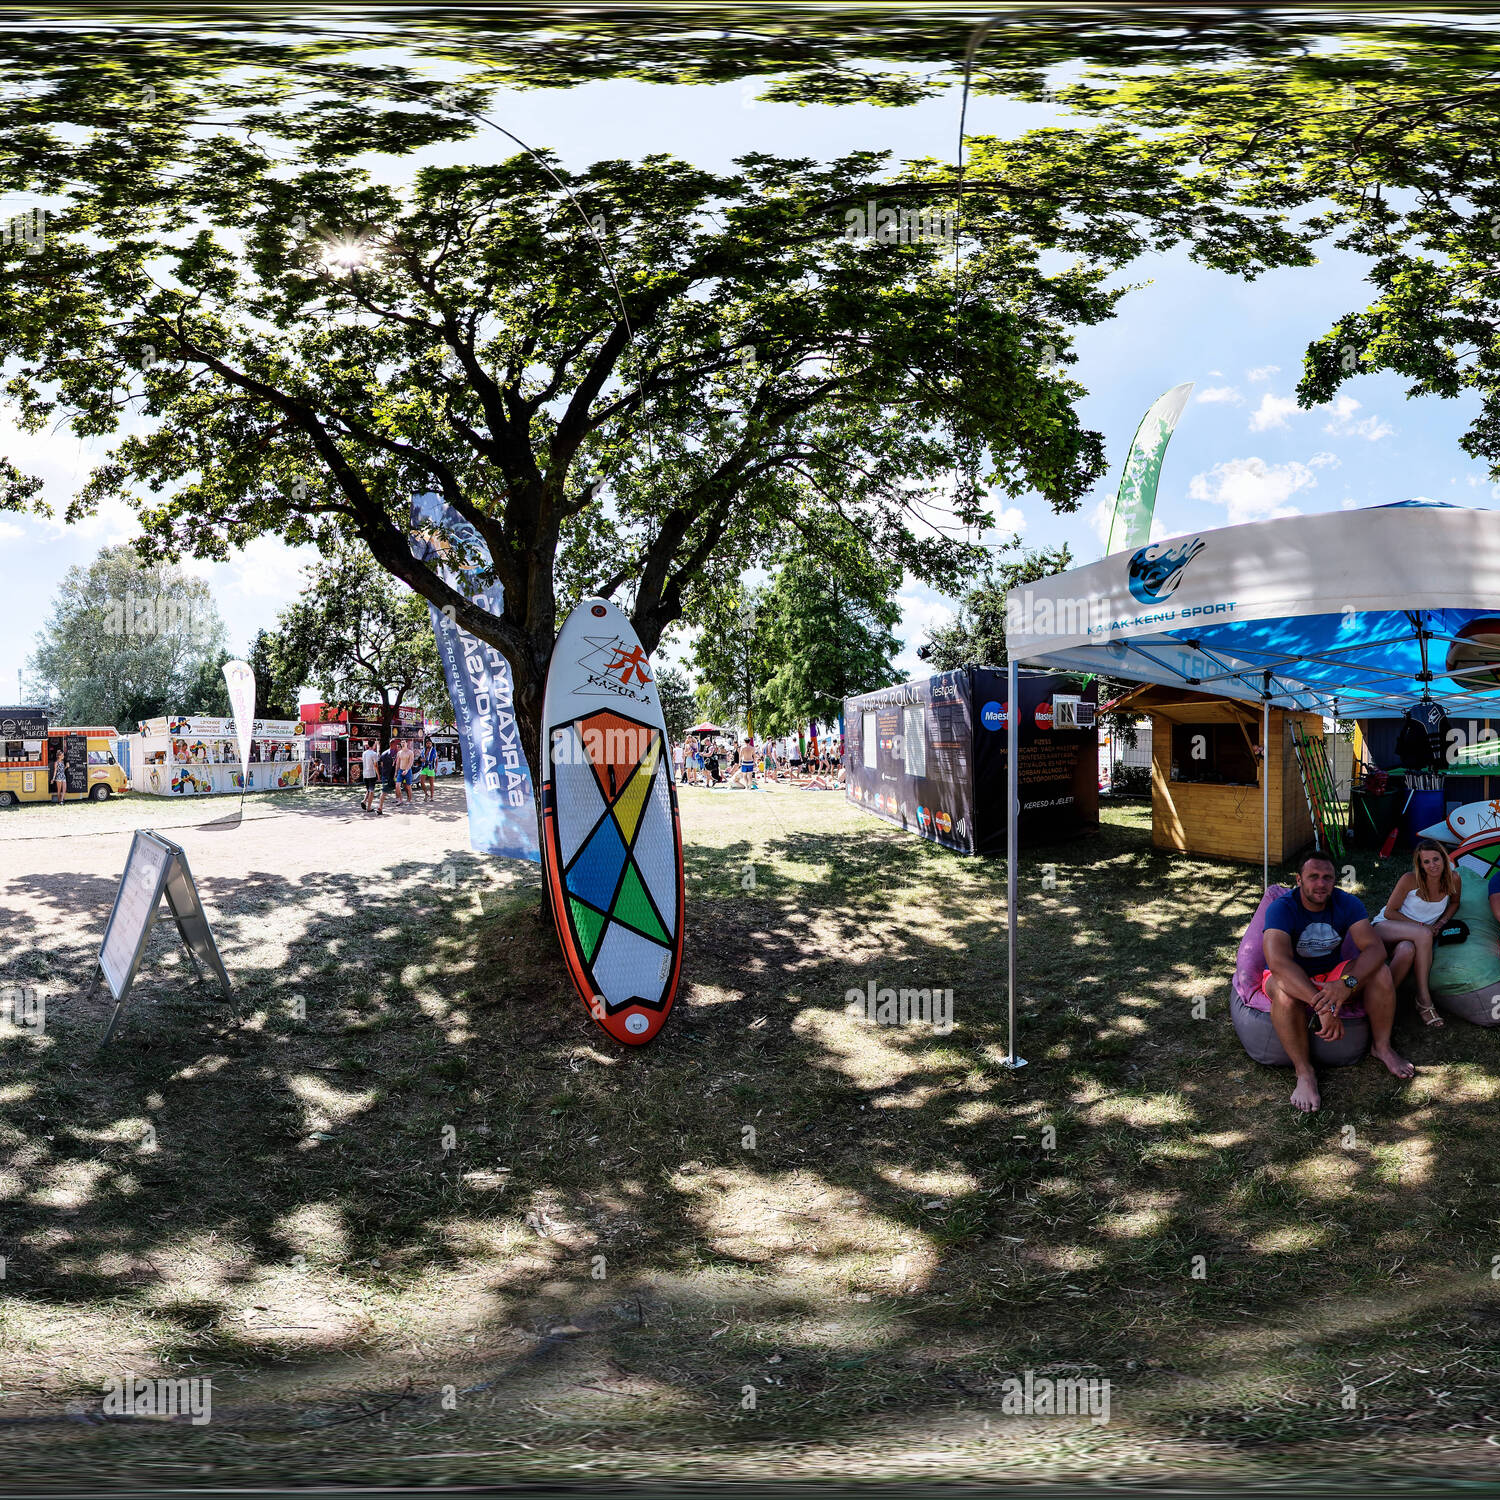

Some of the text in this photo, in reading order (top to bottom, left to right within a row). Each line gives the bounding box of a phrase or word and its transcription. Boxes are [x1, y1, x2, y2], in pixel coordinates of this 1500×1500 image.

[1087, 602, 1237, 636] KAJAK-KENU SPORT
[863, 694, 888, 712] TOP-UP
[889, 685, 924, 707] POINT
[985, 711, 1009, 721] Maest
[1035, 712, 1054, 721] Master
[1024, 800, 1049, 810] KERESD
